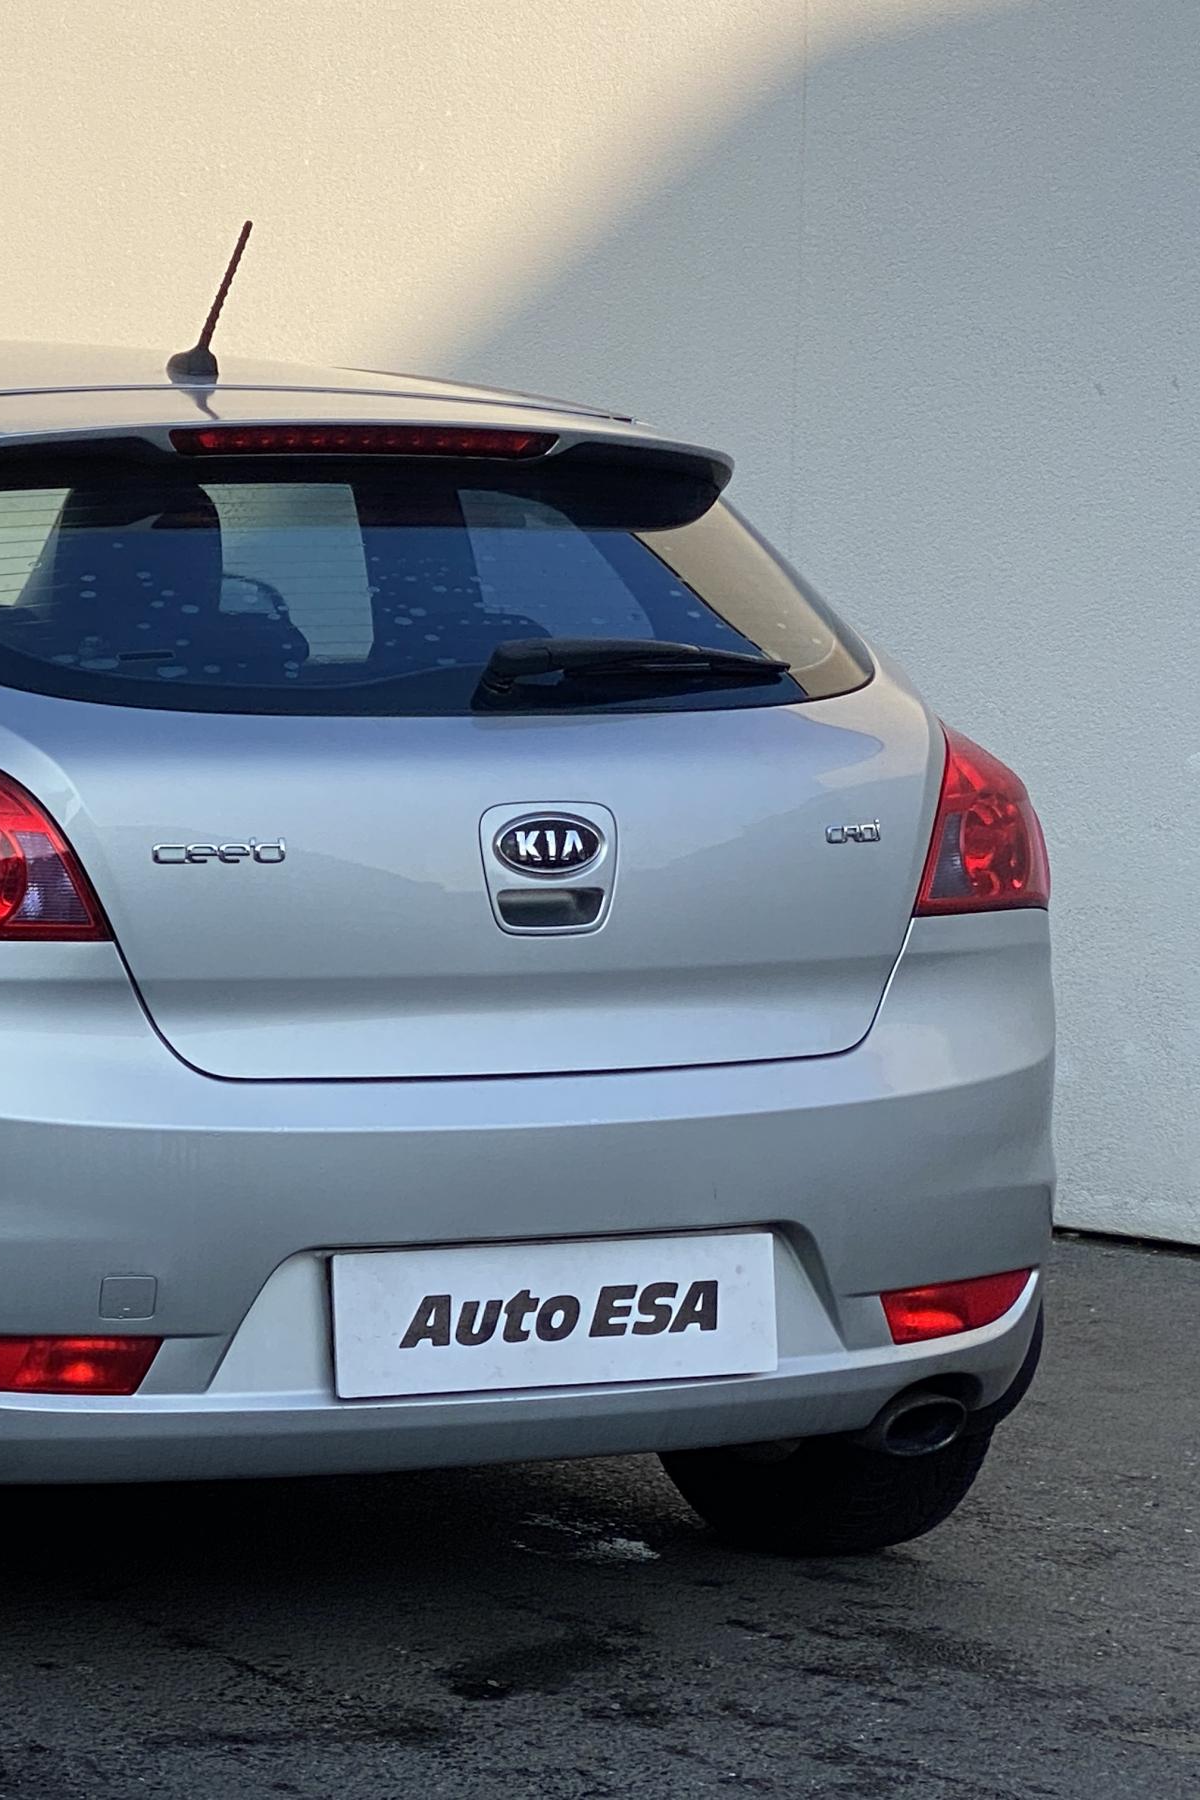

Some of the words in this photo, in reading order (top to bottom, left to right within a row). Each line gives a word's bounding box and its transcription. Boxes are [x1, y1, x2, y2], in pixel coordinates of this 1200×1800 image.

[515, 830, 585, 861] KIA
[399, 1289, 581, 1349] Auto
[588, 1280, 719, 1338] ESA
